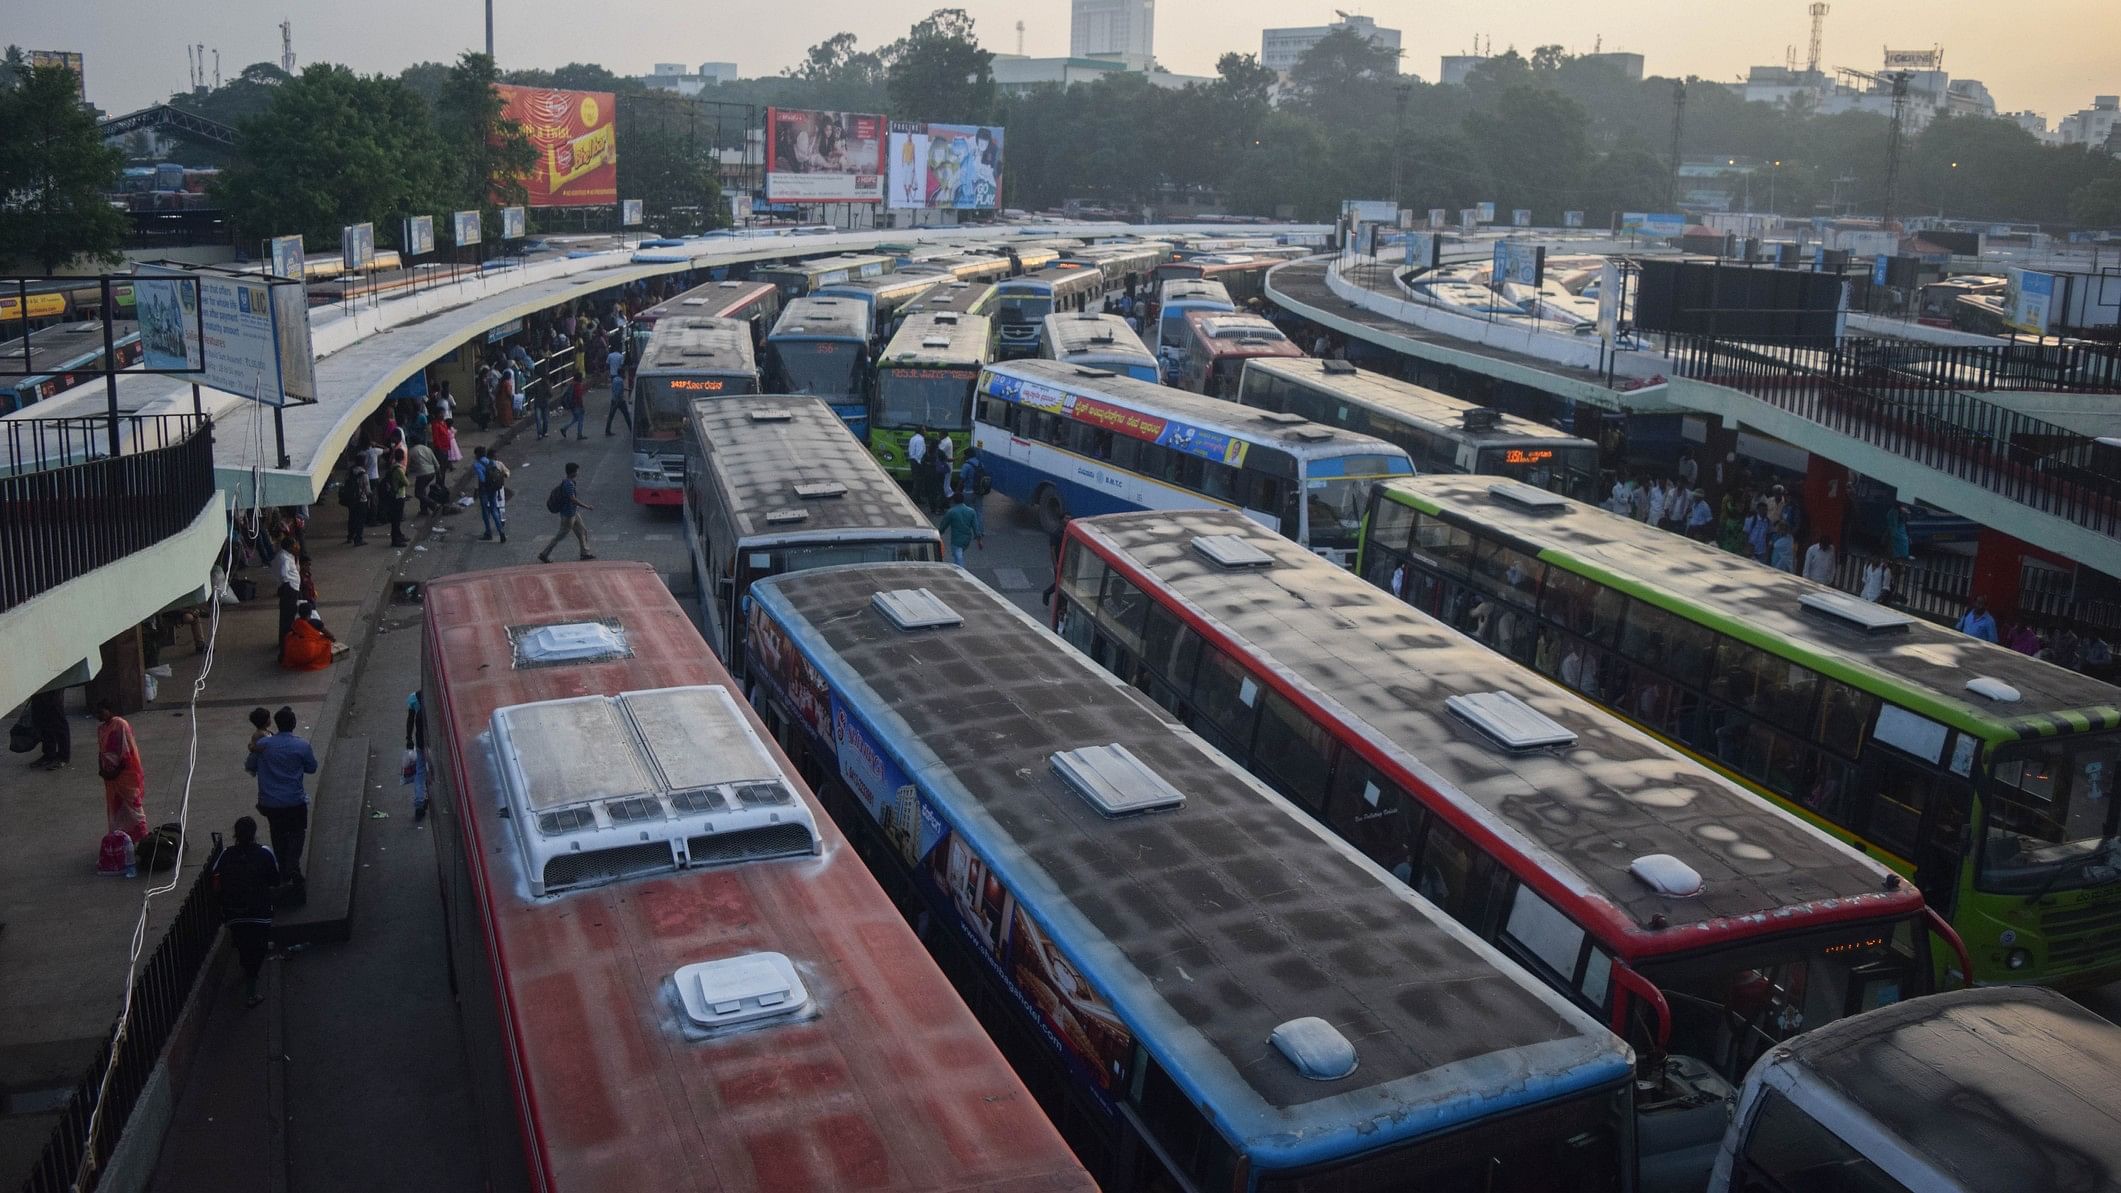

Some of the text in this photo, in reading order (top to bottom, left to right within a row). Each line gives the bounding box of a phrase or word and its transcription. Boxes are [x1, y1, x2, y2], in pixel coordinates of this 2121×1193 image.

[977, 182, 989, 194] GO
[250, 290, 266, 313] LIC
[960, 919, 1063, 1051] www.shenbagahotel.com
